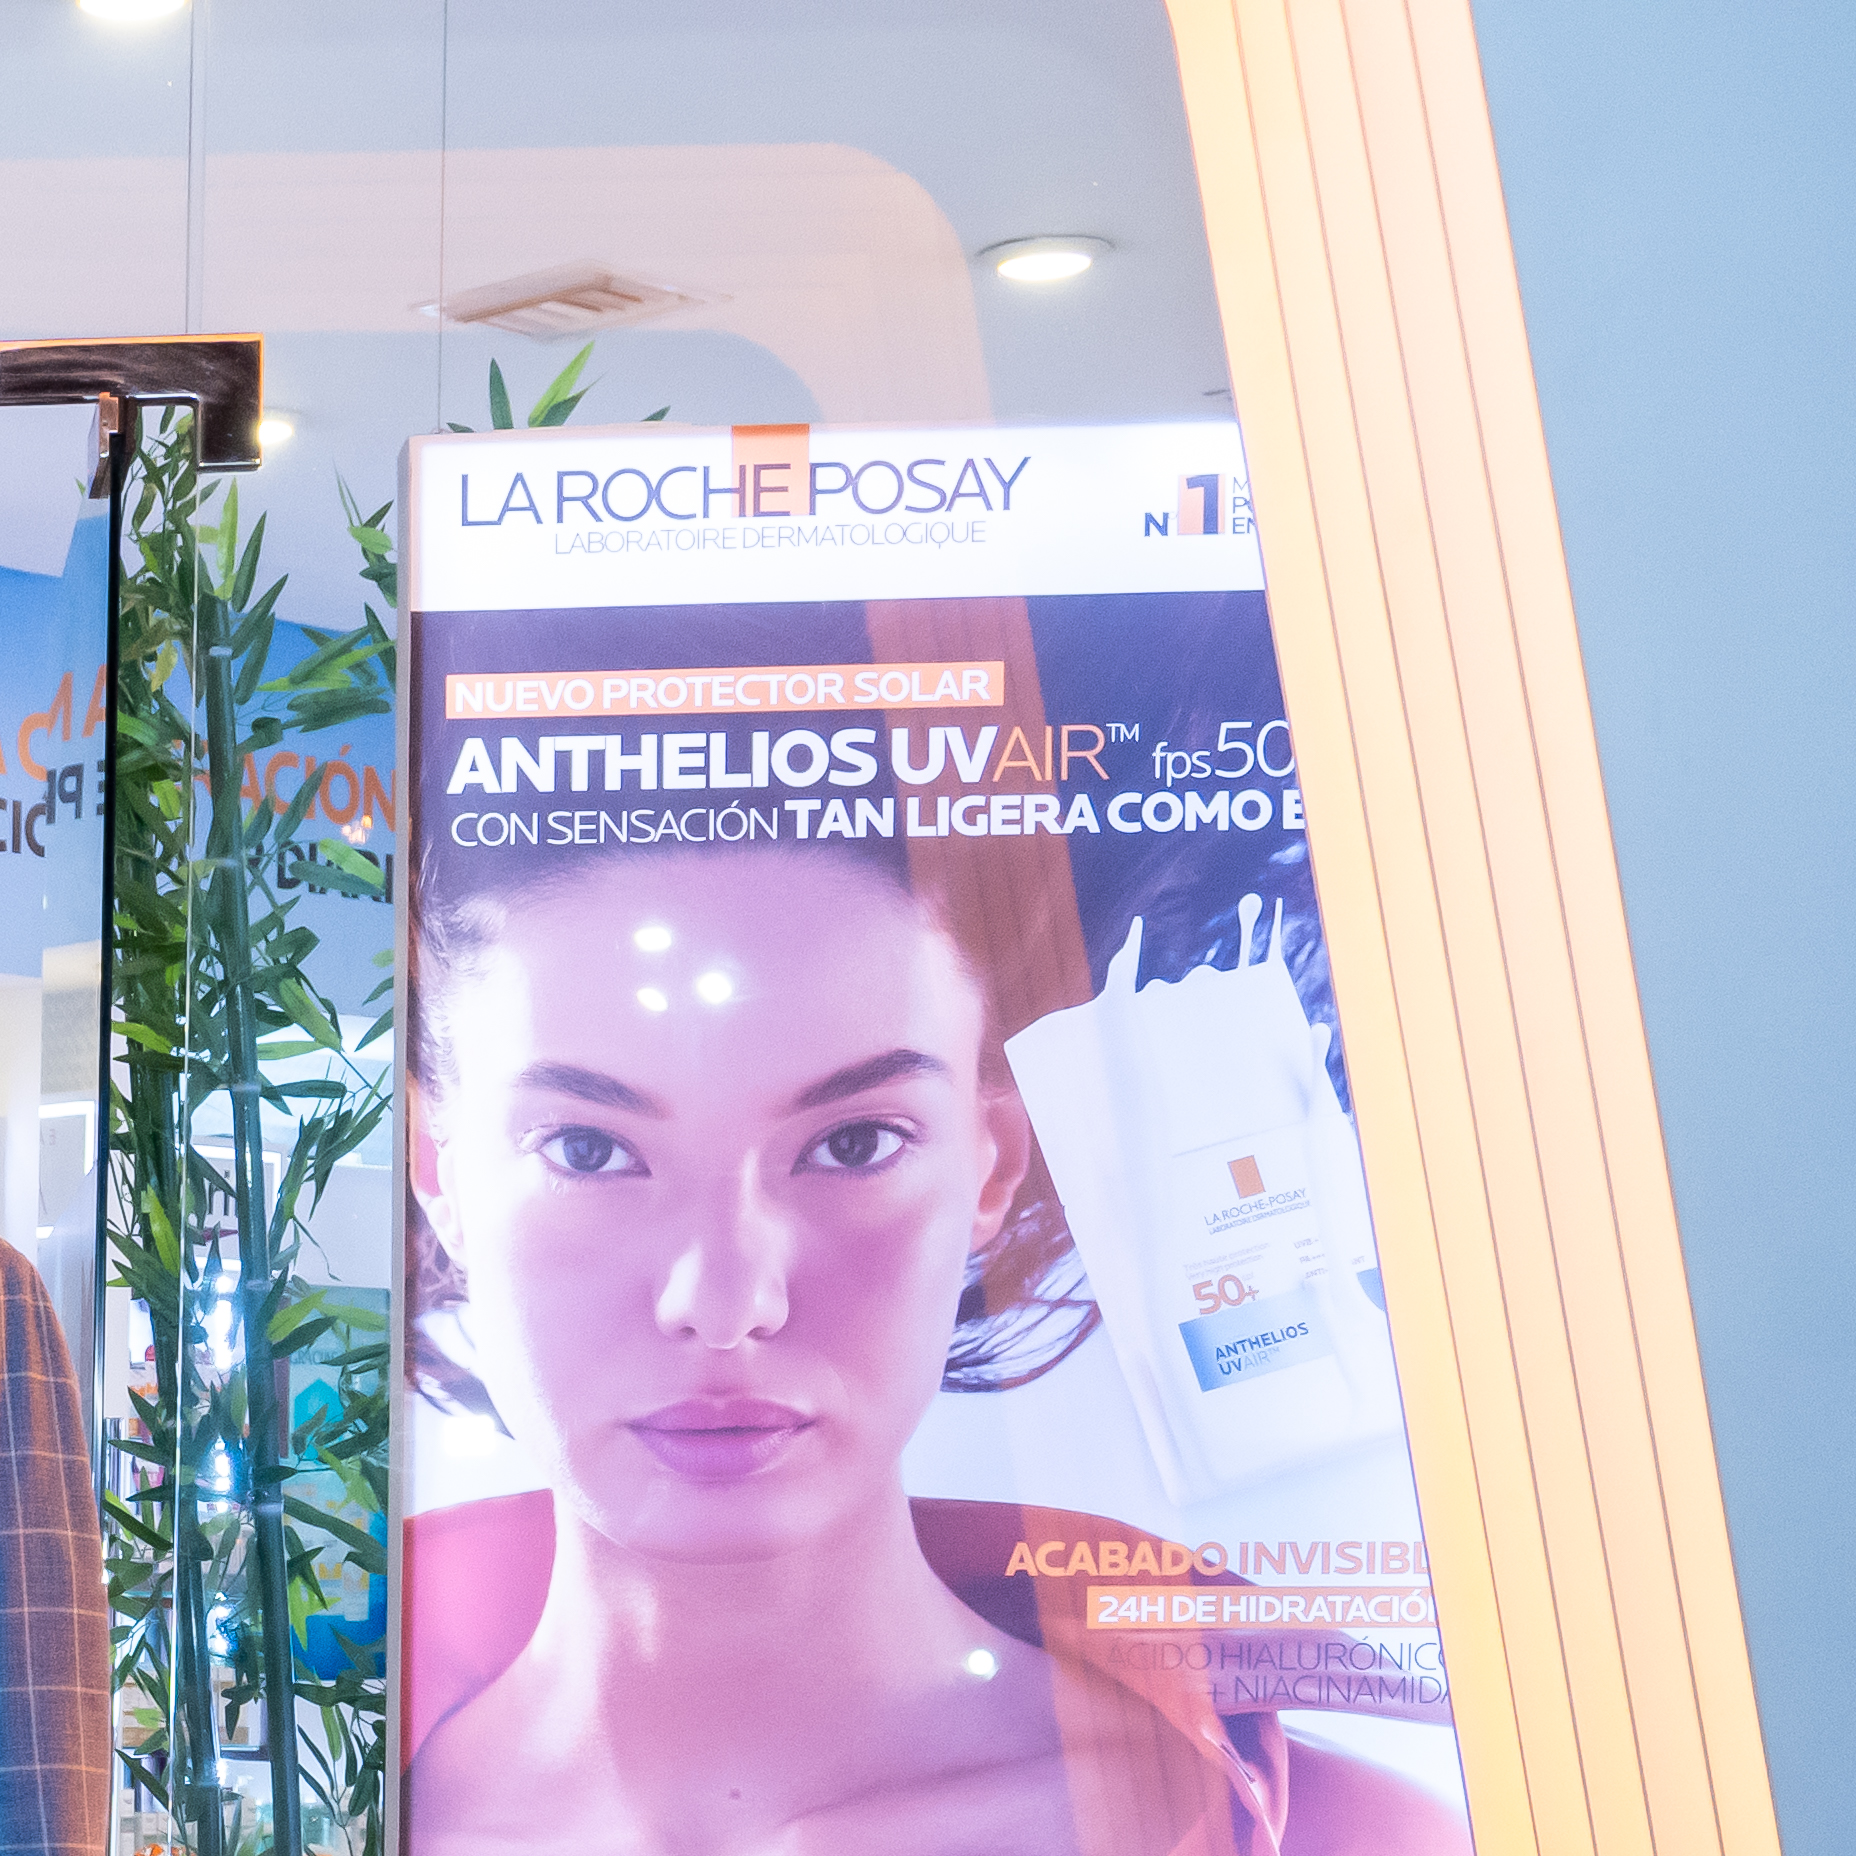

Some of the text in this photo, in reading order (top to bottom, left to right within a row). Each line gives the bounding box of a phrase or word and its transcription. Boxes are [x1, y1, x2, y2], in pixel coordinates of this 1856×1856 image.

[462, 456, 1032, 527] LA ROCHE POSAY
[555, 520, 986, 555] LABORATOIRE DERMATOLOGIQUE
[454, 669, 991, 713] NUEVO PROTECTOR SOLAR
[446, 727, 879, 795] ANTHELIOS
[451, 789, 1305, 847] CON SENSACIÓN TAN LIGERA COMO E
[1192, 1274, 1260, 1315] 50+
[1215, 1322, 1310, 1361] ANTHELIOS
[1004, 1540, 1228, 1577] ACABADO
[1097, 1596, 1164, 1623] 24H
[1172, 1596, 1216, 1623] DE
[1107, 1636, 1212, 1671] ÁCIDO
[1235, 1675, 1447, 1704] NIACINAMID
